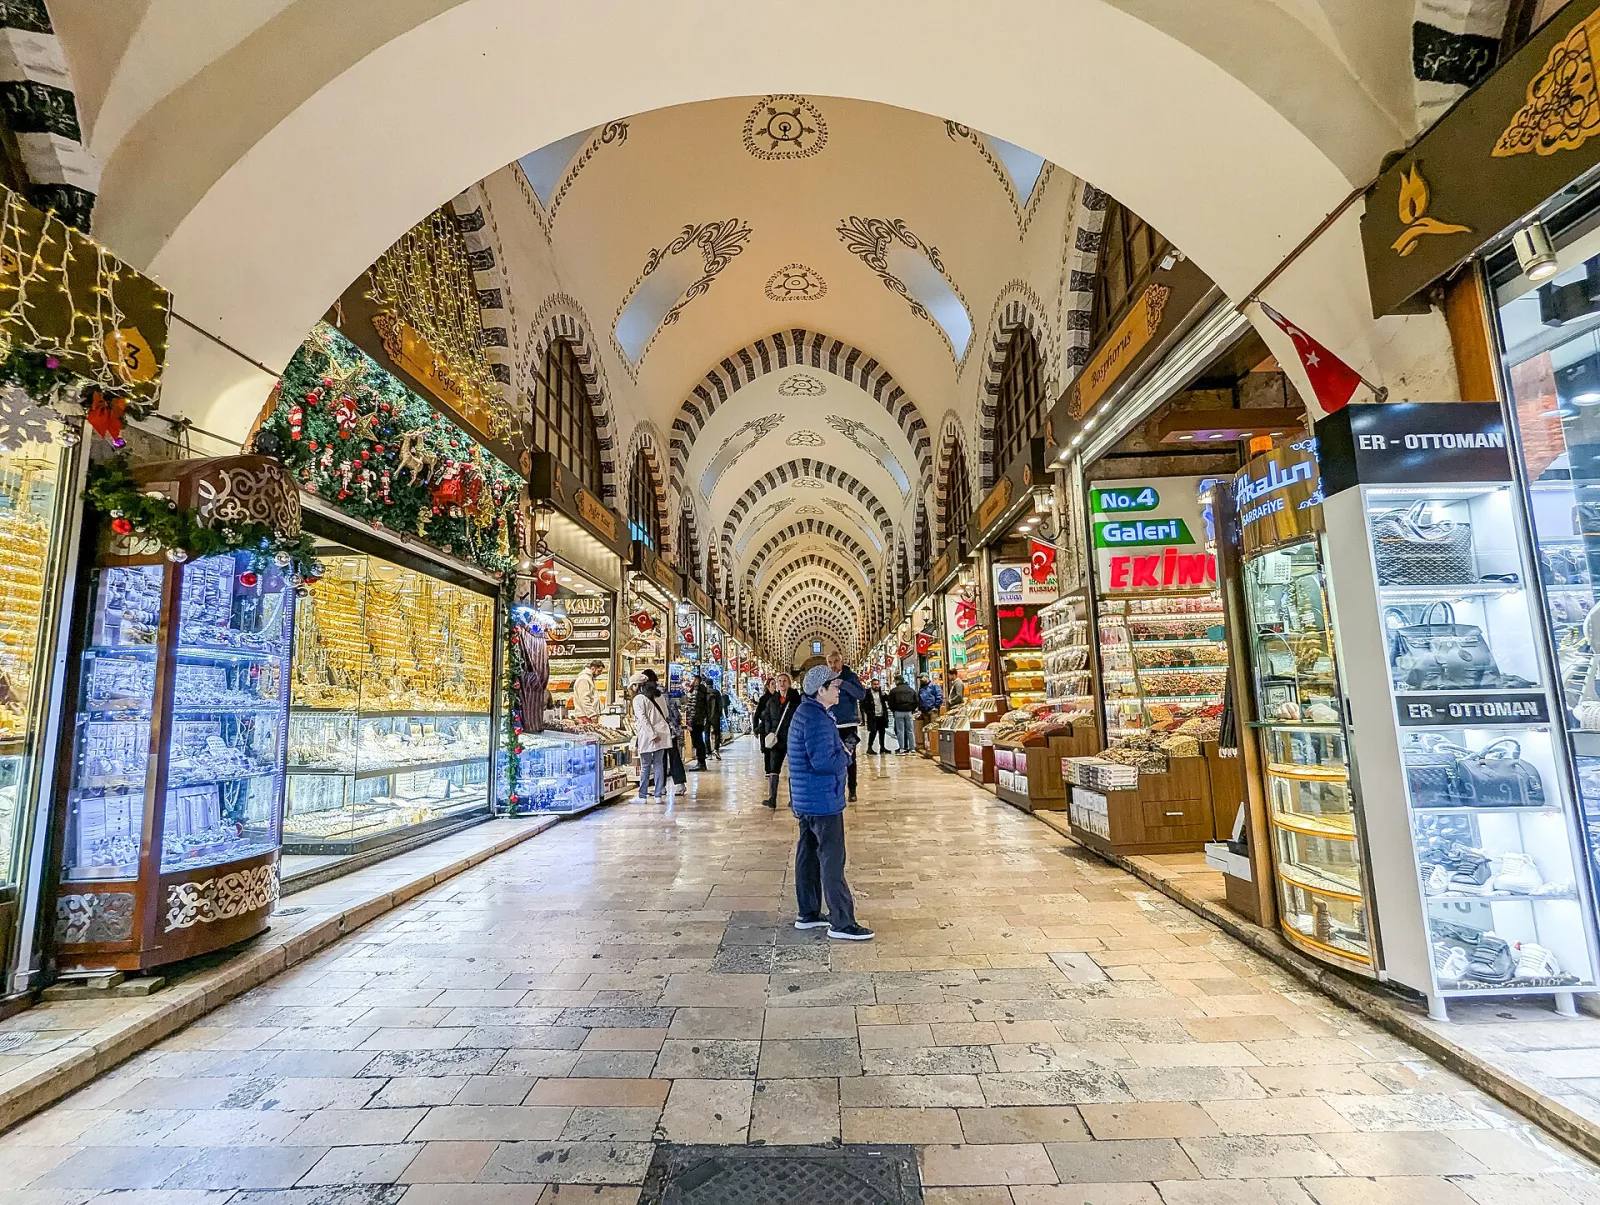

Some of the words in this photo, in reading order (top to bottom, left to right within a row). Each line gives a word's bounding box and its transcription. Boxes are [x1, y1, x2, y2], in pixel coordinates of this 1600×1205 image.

[124, 343, 140, 370] 3
[1091, 330, 1133, 389] Bosphorus
[1358, 434, 1386, 450] ER
[1404, 432, 1505, 449] OTTOMAN
[1101, 487, 1155, 509] No.4
[1242, 498, 1284, 527] SARRAFİYE
[1102, 520, 1178, 542] Galeri
[565, 598, 606, 615] KAUR
[1407, 703, 1433, 718] ER
[1449, 701, 1539, 717] OTTOMAN
